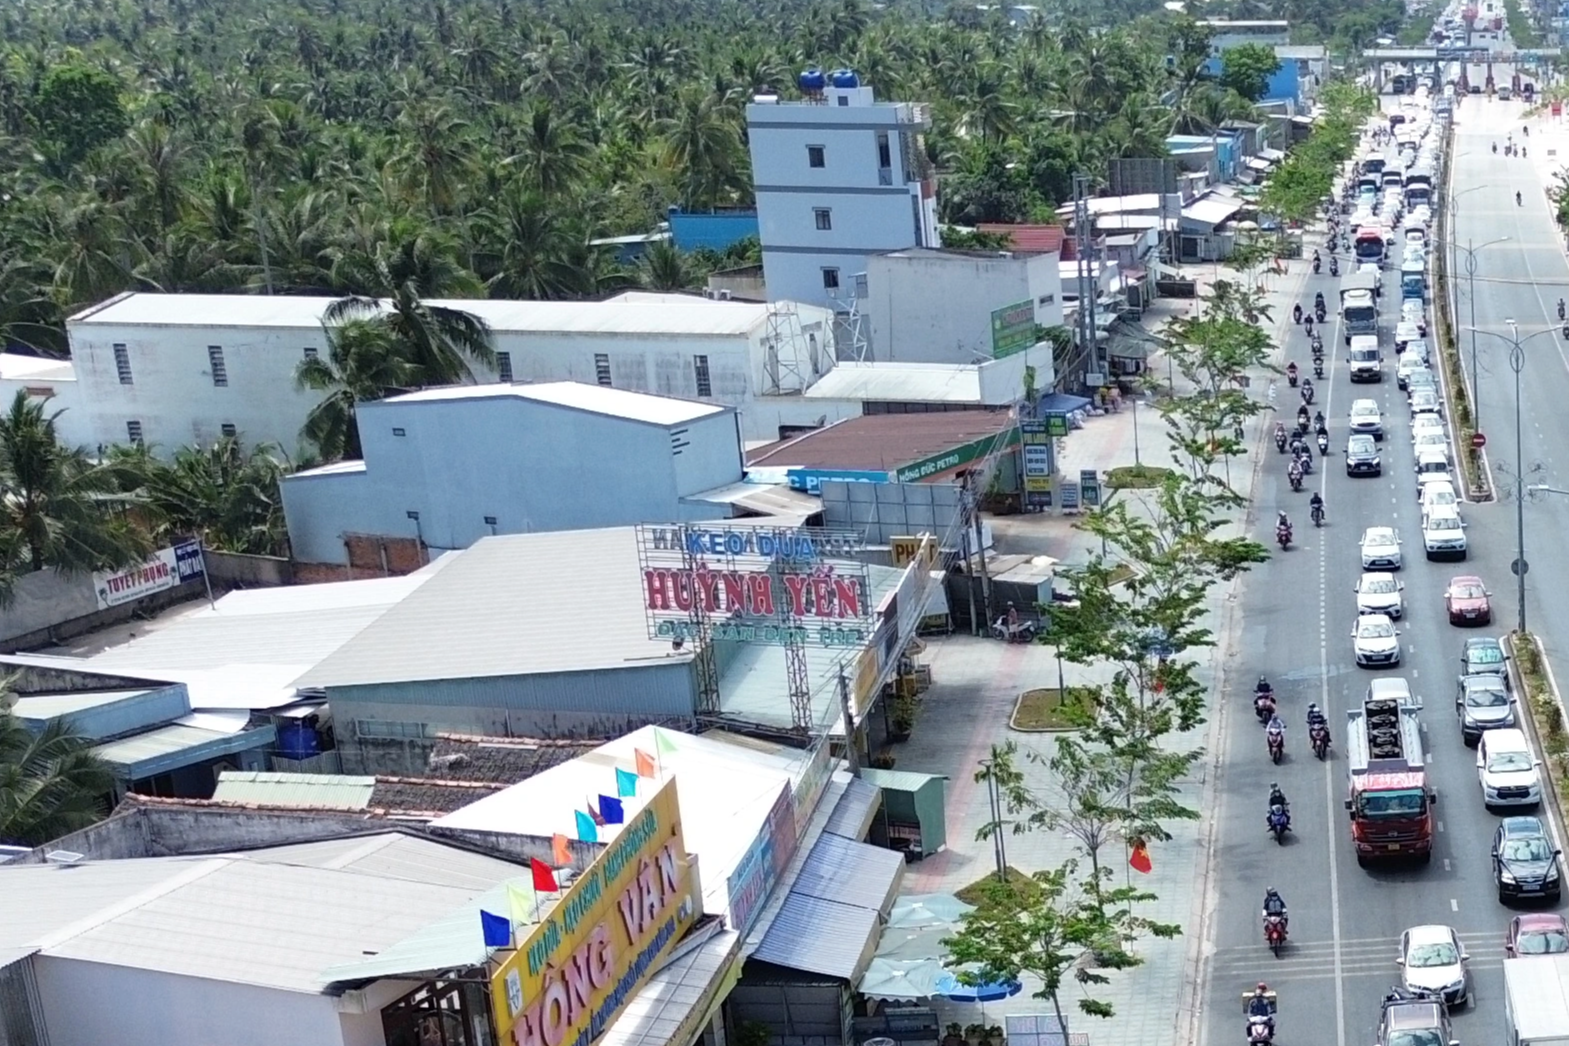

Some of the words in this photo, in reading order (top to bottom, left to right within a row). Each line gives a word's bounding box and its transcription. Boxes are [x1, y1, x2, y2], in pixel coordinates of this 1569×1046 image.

[936, 454, 960, 470] PETRO
[644, 560, 775, 617] HUỲNH
[783, 563, 860, 619] YẾN
[617, 842, 680, 947] VÂN
